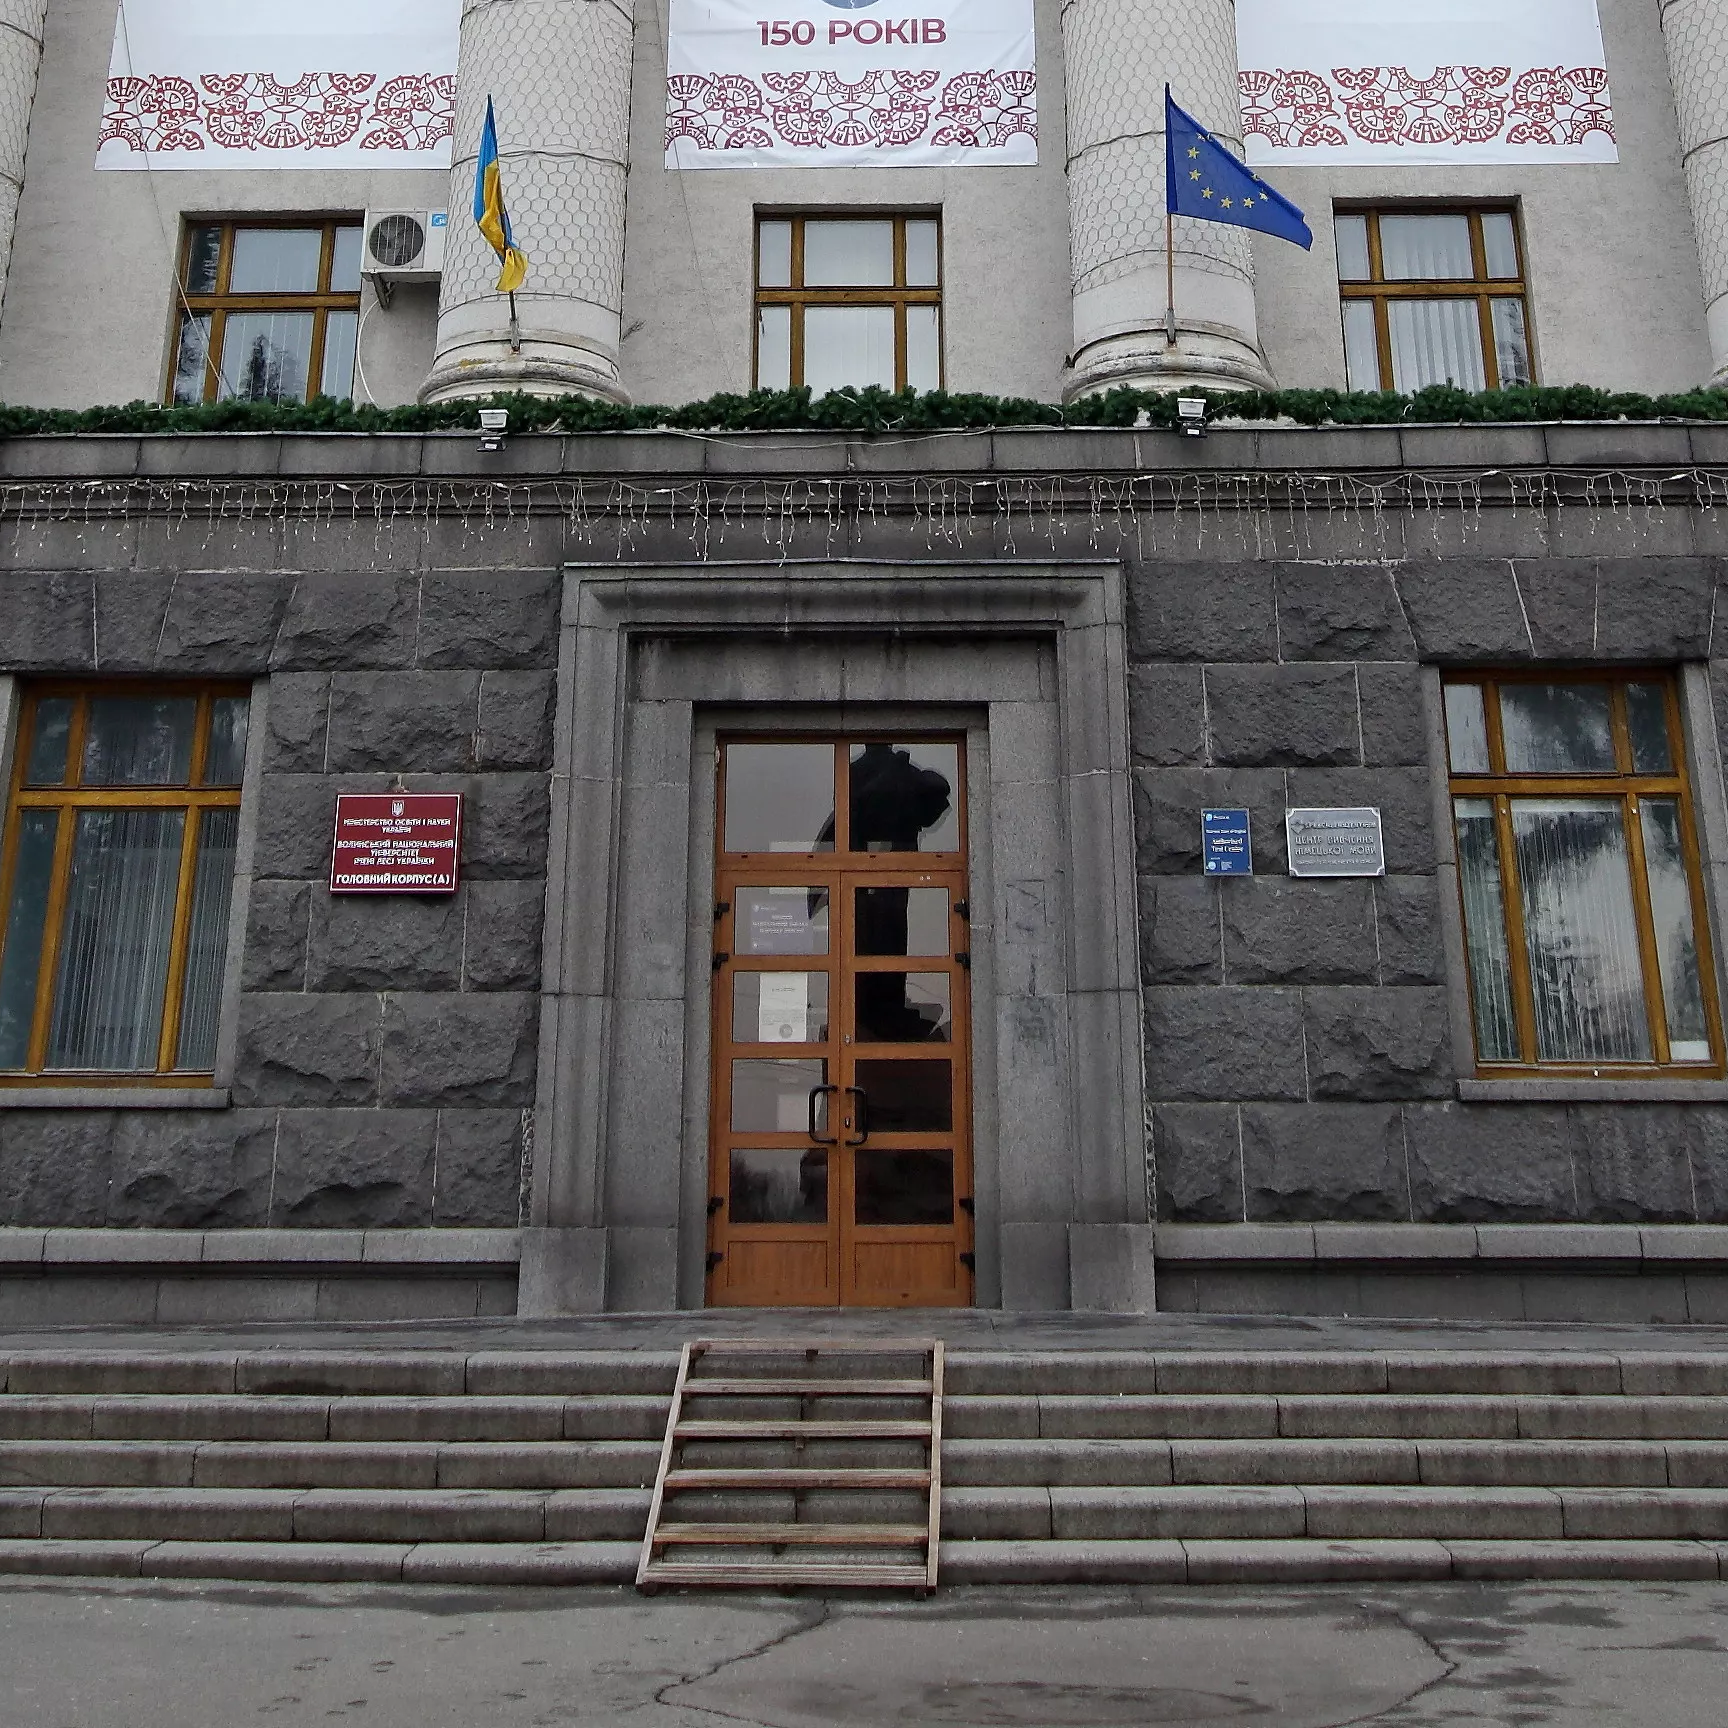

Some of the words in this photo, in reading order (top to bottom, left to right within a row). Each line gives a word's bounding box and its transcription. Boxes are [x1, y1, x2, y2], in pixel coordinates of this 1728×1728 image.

[756, 20, 816, 46] 150
[828, 18, 947, 45] РОКІВ
[335, 872, 391, 885] ГОЛОВНИЙ
[391, 873, 432, 885] КОРПУС
